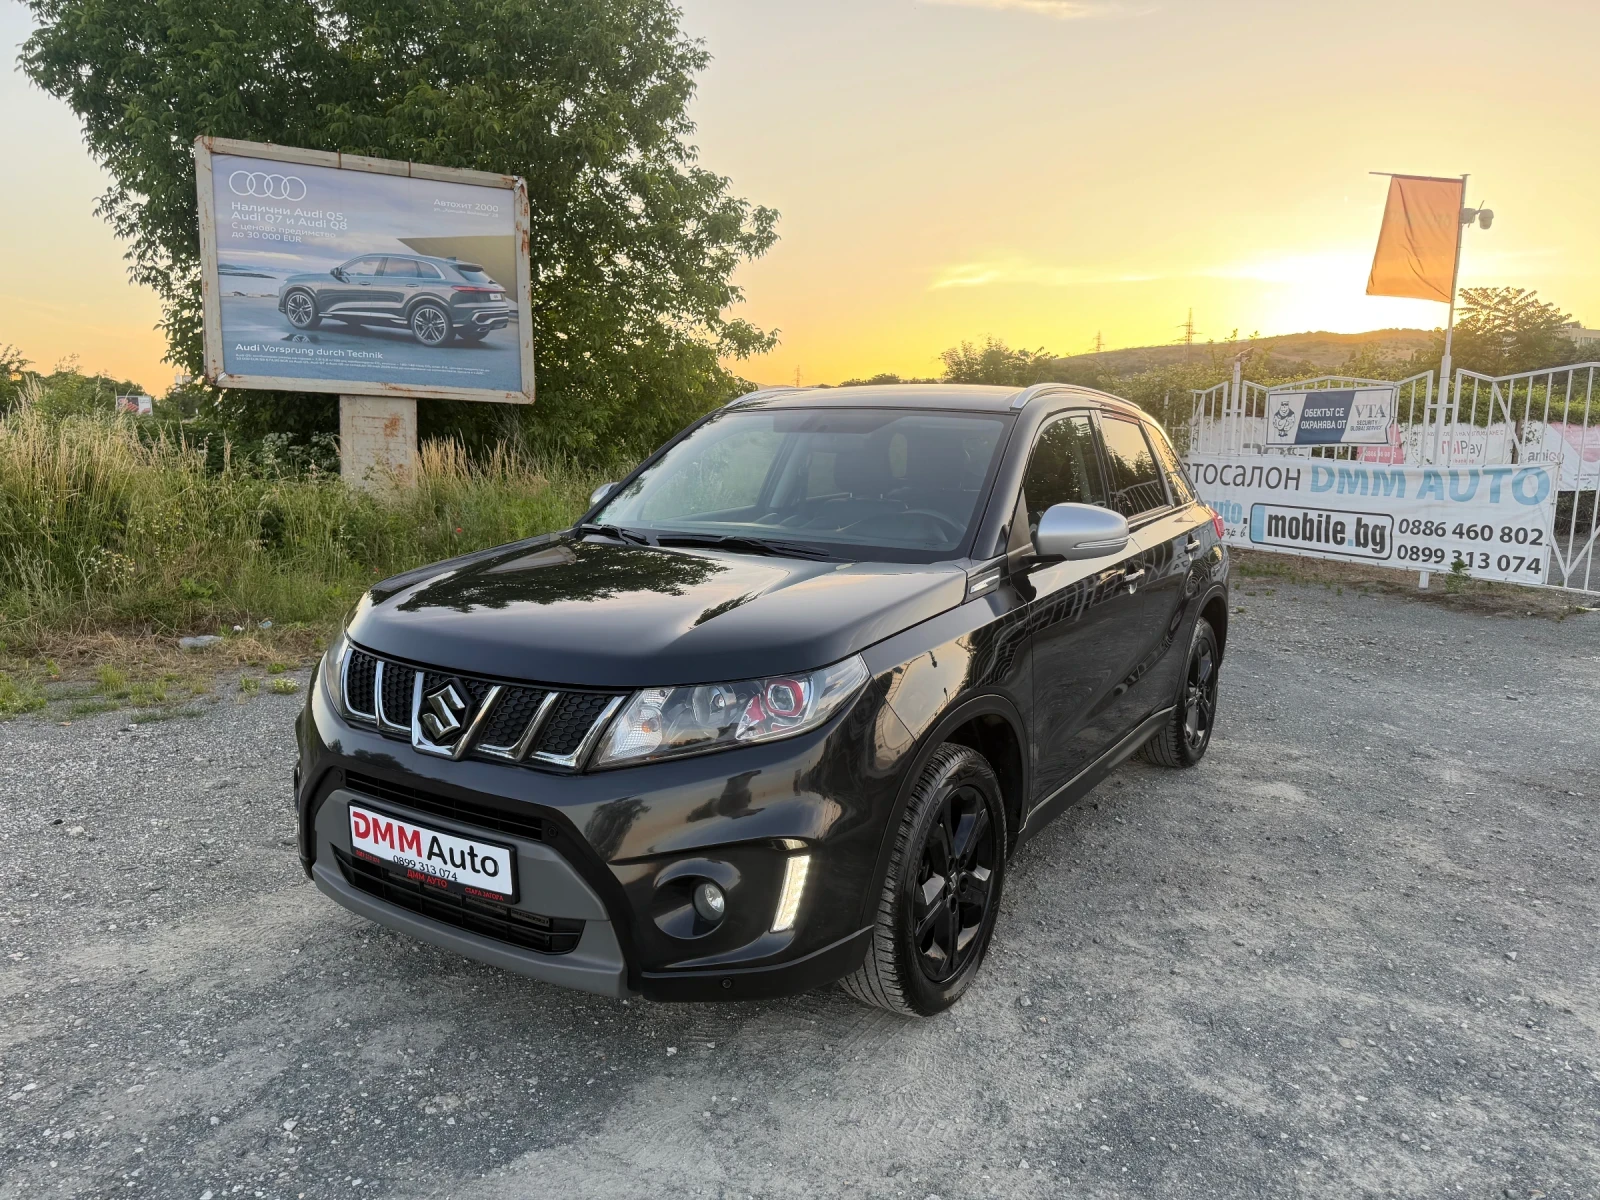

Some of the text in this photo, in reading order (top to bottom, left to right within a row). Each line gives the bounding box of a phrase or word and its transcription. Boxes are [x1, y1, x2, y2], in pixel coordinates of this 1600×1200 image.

[231, 202, 348, 222] Налични Audi Q5,
[434, 199, 498, 212] Автохит 2000
[231, 211, 261, 221] Audi
[264, 214, 282, 224] Q7
[298, 218, 326, 228] Audi
[330, 221, 348, 231] Q8
[240, 223, 276, 232] ценово
[278, 227, 336, 238] предимство
[262, 232, 280, 240] 000
[284, 234, 302, 242] EUR
[235, 343, 384, 359] Audi Vorsprung durch Technik
[1304, 408, 1344, 418] ОБЕКТЪТ СЕ
[1354, 404, 1386, 418] VTA
[1300, 420, 1346, 430] ОХРАНЯВА ОТ
[1310, 463, 1406, 499] DMM
[1416, 466, 1550, 506] AUTO
[1267, 512, 1386, 554] mobile.bg
[1398, 518, 1544, 546] 0886 460 802
[1397, 544, 1542, 574] 0899 313 074
[352, 810, 500, 877] DMM Auto
[393, 854, 458, 881] 0899 313 074
[406, 869, 448, 888] ДММ АУТО
